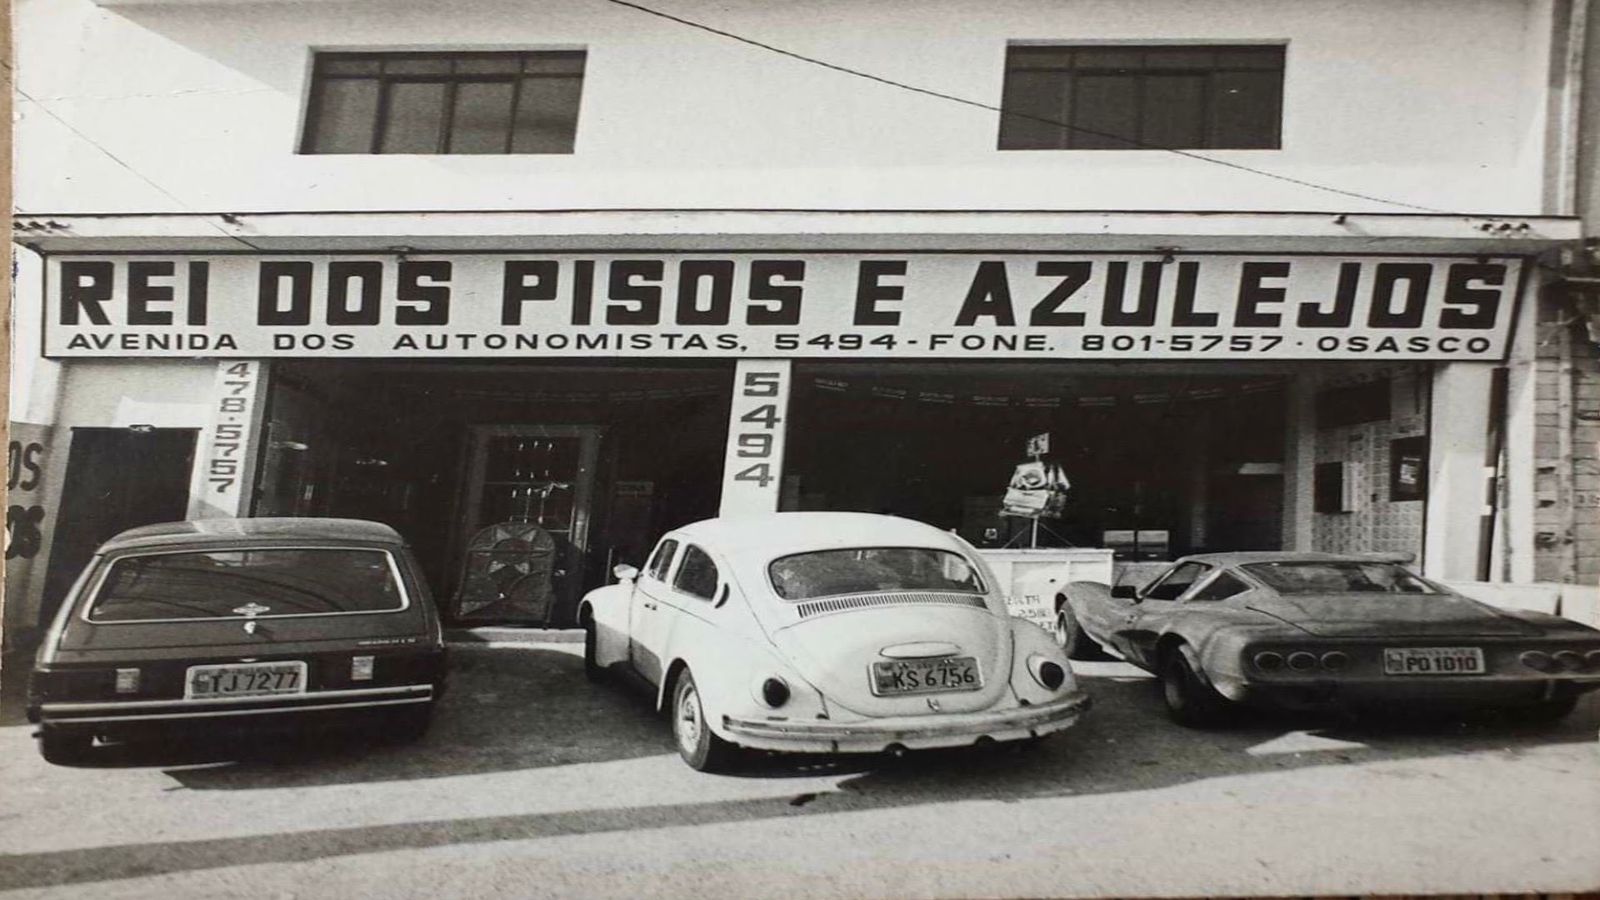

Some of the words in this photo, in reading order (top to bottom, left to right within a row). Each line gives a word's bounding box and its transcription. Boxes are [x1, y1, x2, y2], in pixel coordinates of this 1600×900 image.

[60, 260, 210, 326] REI
[257, 260, 453, 326] DOS
[502, 260, 806, 326] PISOS
[853, 260, 908, 326] E
[954, 260, 1508, 330] AZULEJOS
[67, 333, 238, 350] AVENIDA
[274, 333, 354, 350] DOS
[393, 333, 747, 351] AUTONOMISTAS,
[1081, 334, 1283, 352] 801-5757
[1317, 335, 1491, 354] OSASCO
[734, 372, 781, 487] 5494
[925, 666, 975, 687] 6756
